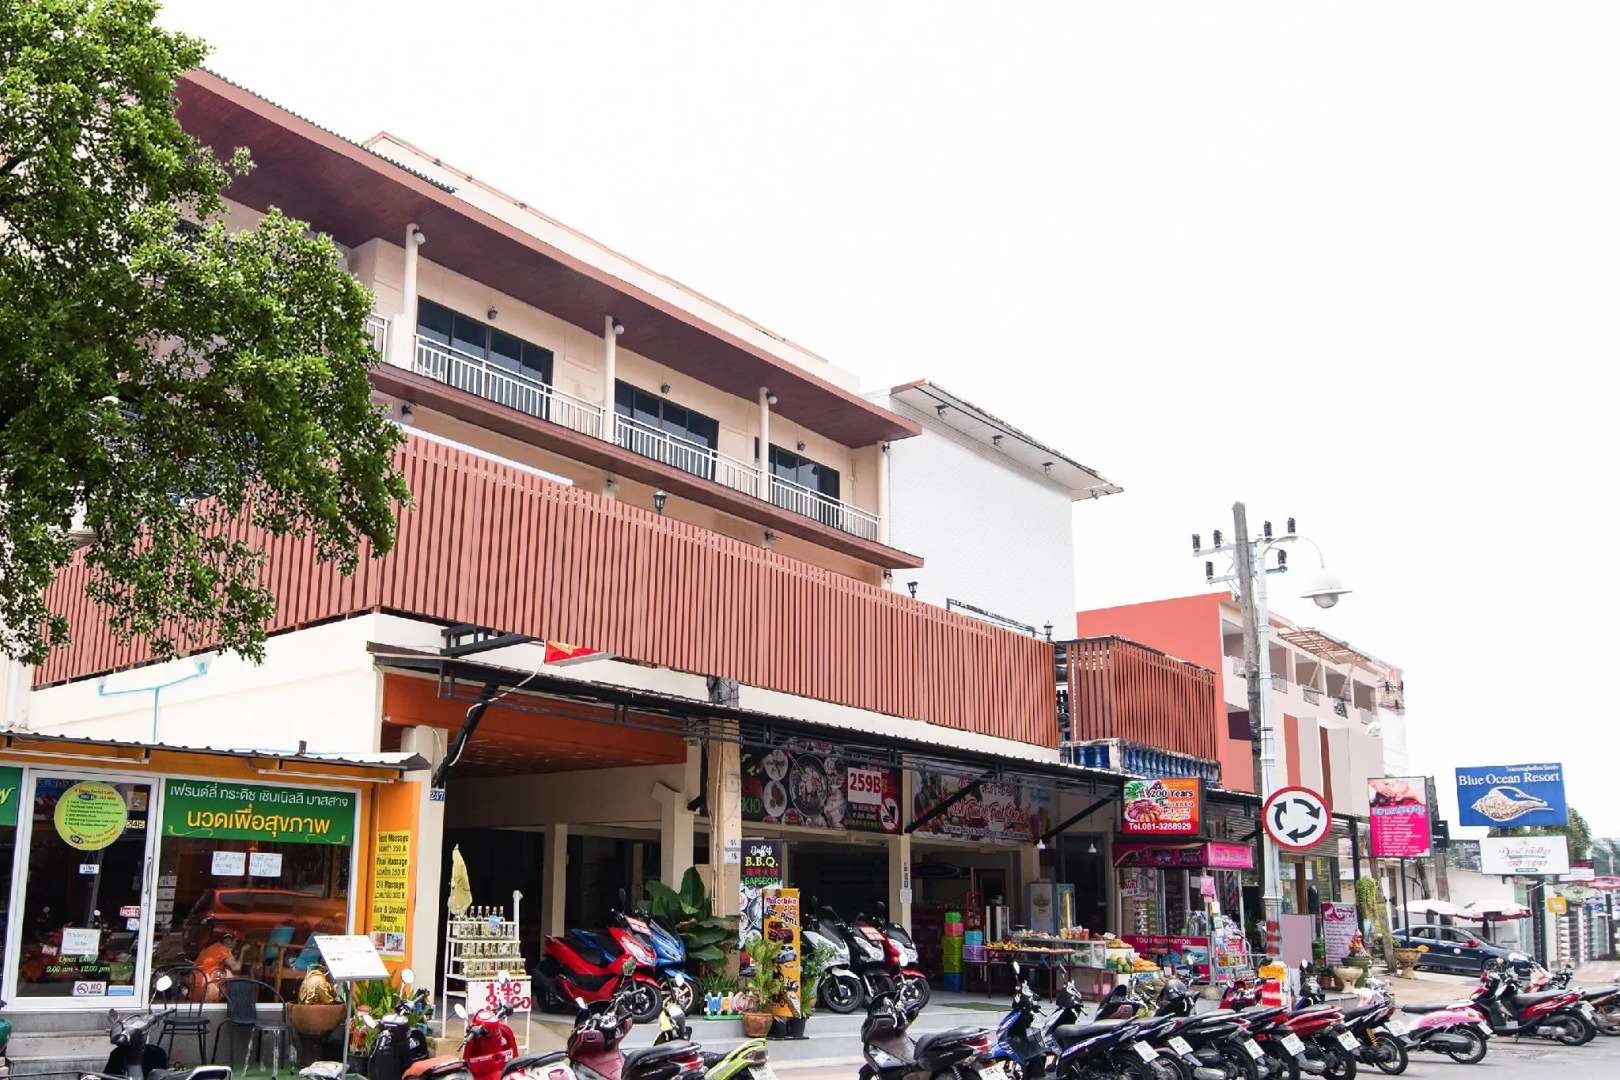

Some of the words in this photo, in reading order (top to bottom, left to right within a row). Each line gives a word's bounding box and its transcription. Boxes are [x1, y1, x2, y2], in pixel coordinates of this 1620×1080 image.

[849, 772, 881, 794] 259B
[1458, 775, 1484, 786] Blue
[1485, 773, 1520, 785] Ocean
[1523, 771, 1560, 783] Resort
[430, 791, 444, 801] 247
[1151, 789, 1168, 798] 200
[1169, 789, 1194, 798] Years
[187, 803, 331, 839] นวดเพื่อสุขภาพ
[388, 834, 409, 843] Massage
[387, 857, 408, 867] Massage
[745, 856, 779, 868] B.B.Q.
[384, 880, 405, 891] Massage
[765, 897, 797, 905] Motorbike
[58, 955, 77, 963] Open
[90, 983, 102, 991] NO
